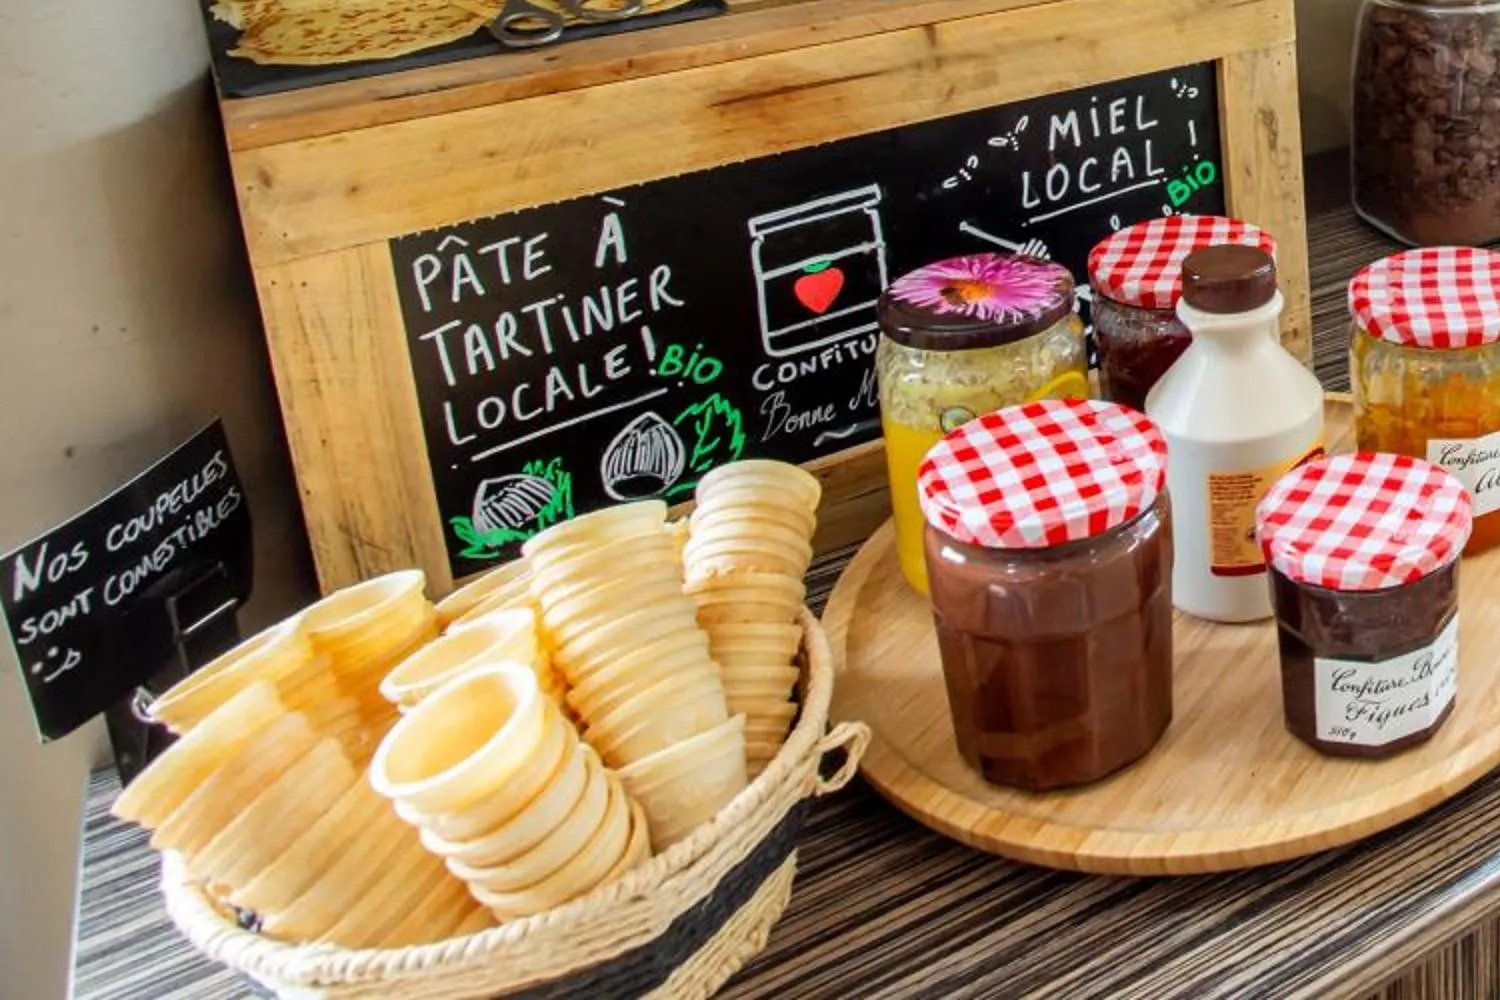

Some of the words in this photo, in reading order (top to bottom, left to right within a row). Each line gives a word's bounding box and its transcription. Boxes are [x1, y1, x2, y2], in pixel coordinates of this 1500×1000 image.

[1021, 138, 1165, 210] LOCAL
[411, 232, 553, 313] PÂTE
[594, 195, 628, 268] À
[759, 390, 838, 442] Bonne
[104, 449, 229, 553] COUPELLES
[17, 585, 95, 645] SONT
[1331, 667, 1409, 700] Confiture
[1345, 691, 1430, 730] Figues
